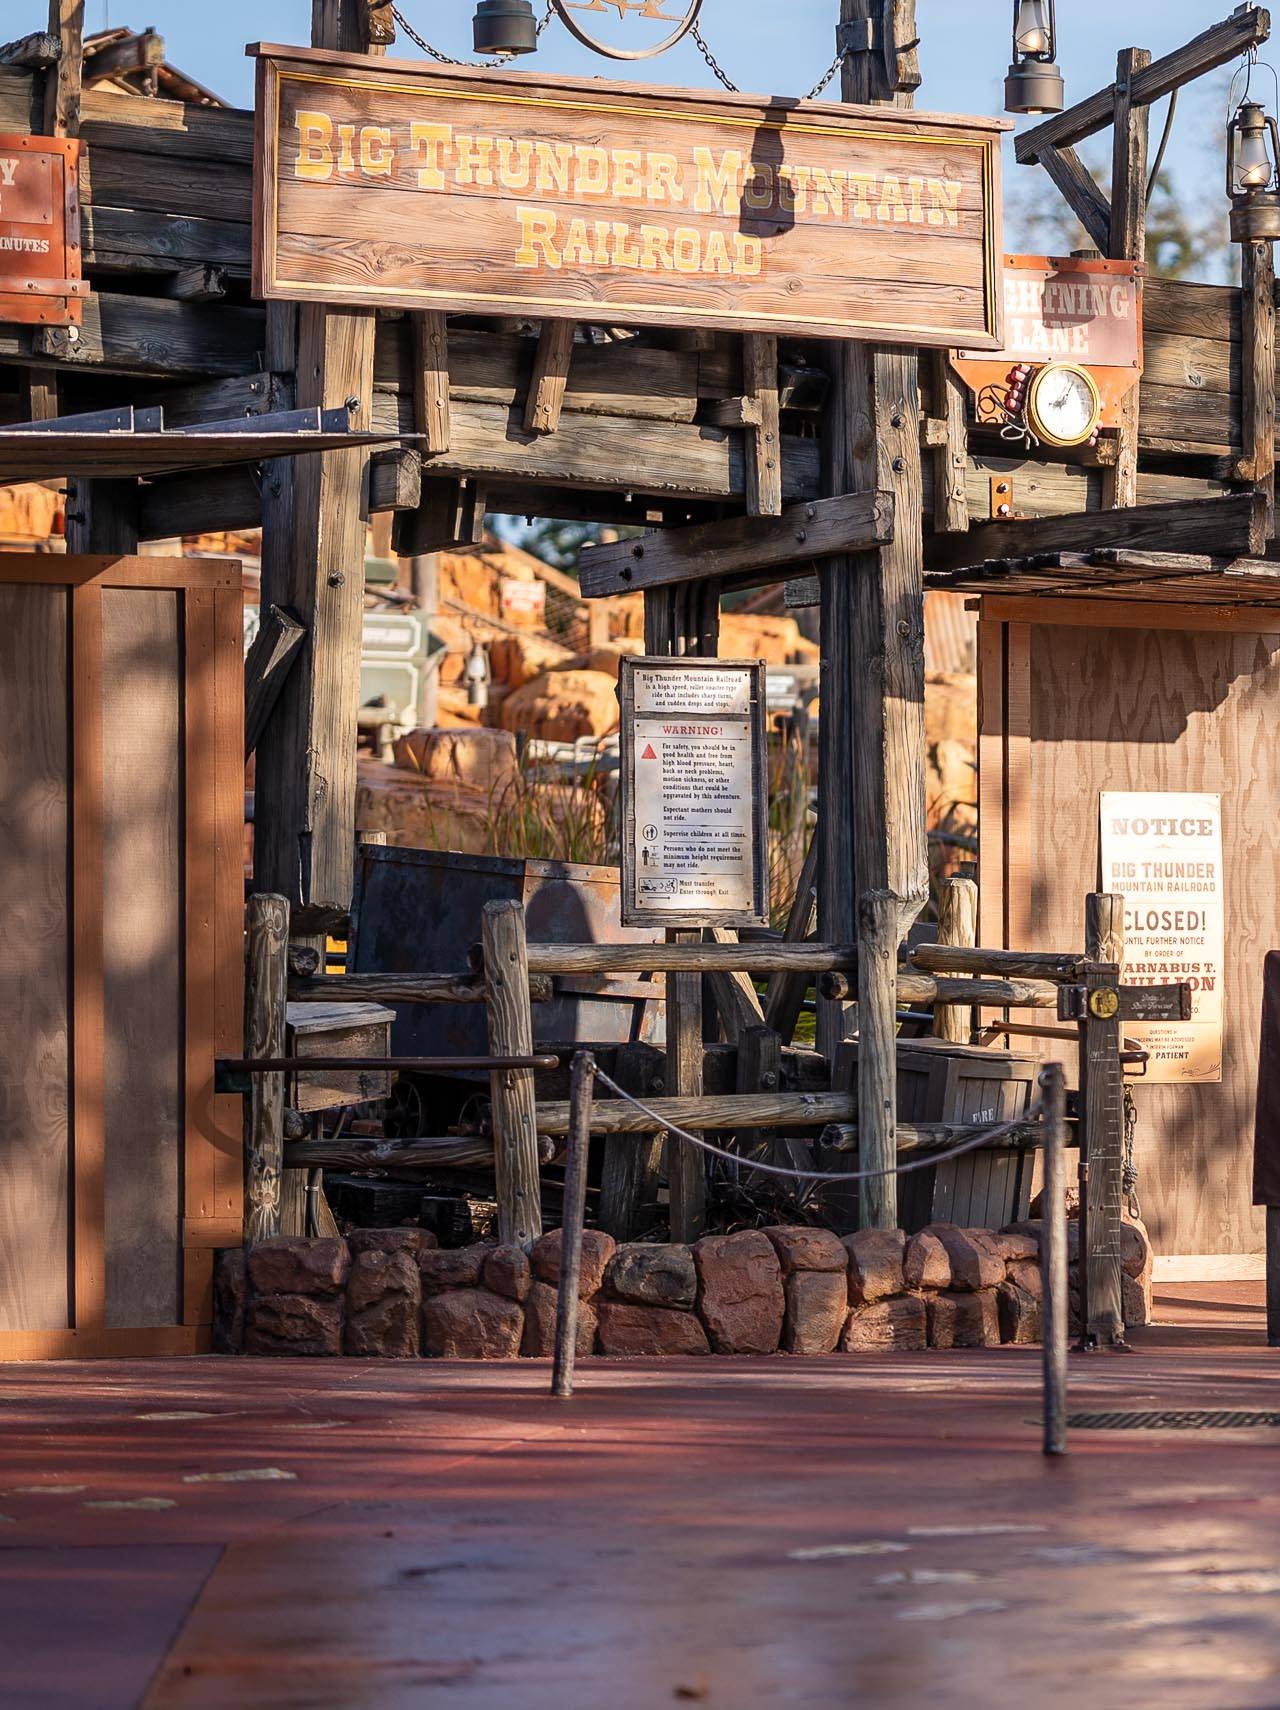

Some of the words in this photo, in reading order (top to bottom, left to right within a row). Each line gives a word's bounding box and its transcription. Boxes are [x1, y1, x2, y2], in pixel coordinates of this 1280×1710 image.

[409, 121, 684, 201] THUNDER
[693, 146, 962, 227] MOUNTAIN
[0, 237, 49, 253] INUTES
[514, 205, 762, 276] RAILROAD
[1003, 278, 1130, 320] GHTNING
[1010, 318, 1089, 354] LANE
[642, 674, 653, 683] Big
[662, 726, 724, 736] WARNING!
[1111, 818, 1213, 836] NOTICE
[1111, 862, 1136, 878] BIG
[1142, 862, 1215, 878] THUNDER
[1112, 882, 1164, 892] MOUNTAIN
[1167, 882, 1216, 892] RAILROAD
[1146, 937, 1177, 945] FURTHER
[1180, 937, 1204, 945] NOTICE
[1124, 963, 1200, 973] ARNABUS
[1204, 963, 1216, 973] T.
[1156, 1052, 1190, 1060] PATIENT
[972, 1108, 994, 1123] FIRE
